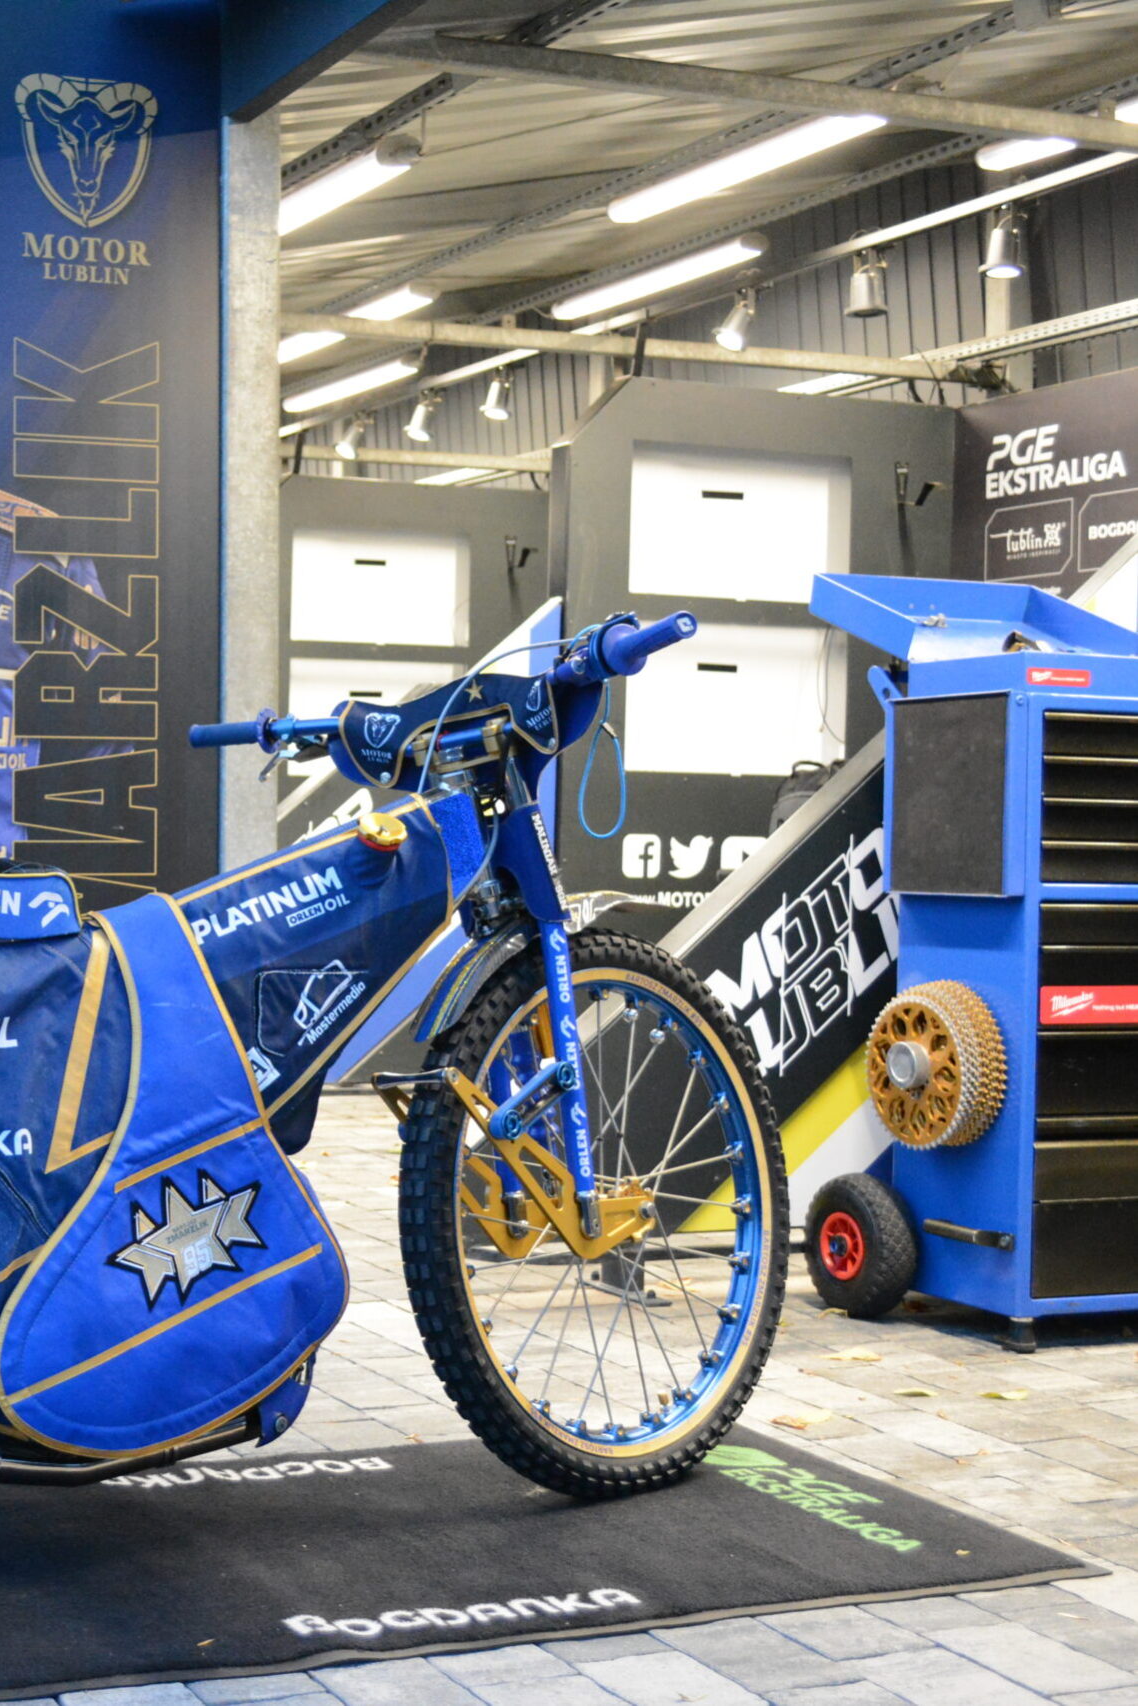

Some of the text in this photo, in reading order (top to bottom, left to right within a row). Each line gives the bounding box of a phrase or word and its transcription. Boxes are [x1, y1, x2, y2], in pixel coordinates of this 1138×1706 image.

[21, 231, 151, 267] MOTOR
[43, 263, 131, 286] LUBLIN
[986, 423, 1061, 472] PGE
[985, 450, 1128, 500] EKSTRALIGA
[1088, 519, 1138, 541] BOGDA
[191, 866, 343, 945] PLATINUM
[287, 893, 351, 926] ORLEN OIL
[557, 953, 571, 1003] ORLEN
[574, 1128, 591, 1177] ORLEN
[718, 1467, 923, 1553] EKSTRALIGA
[282, 1587, 643, 1641] BOGDANKA
